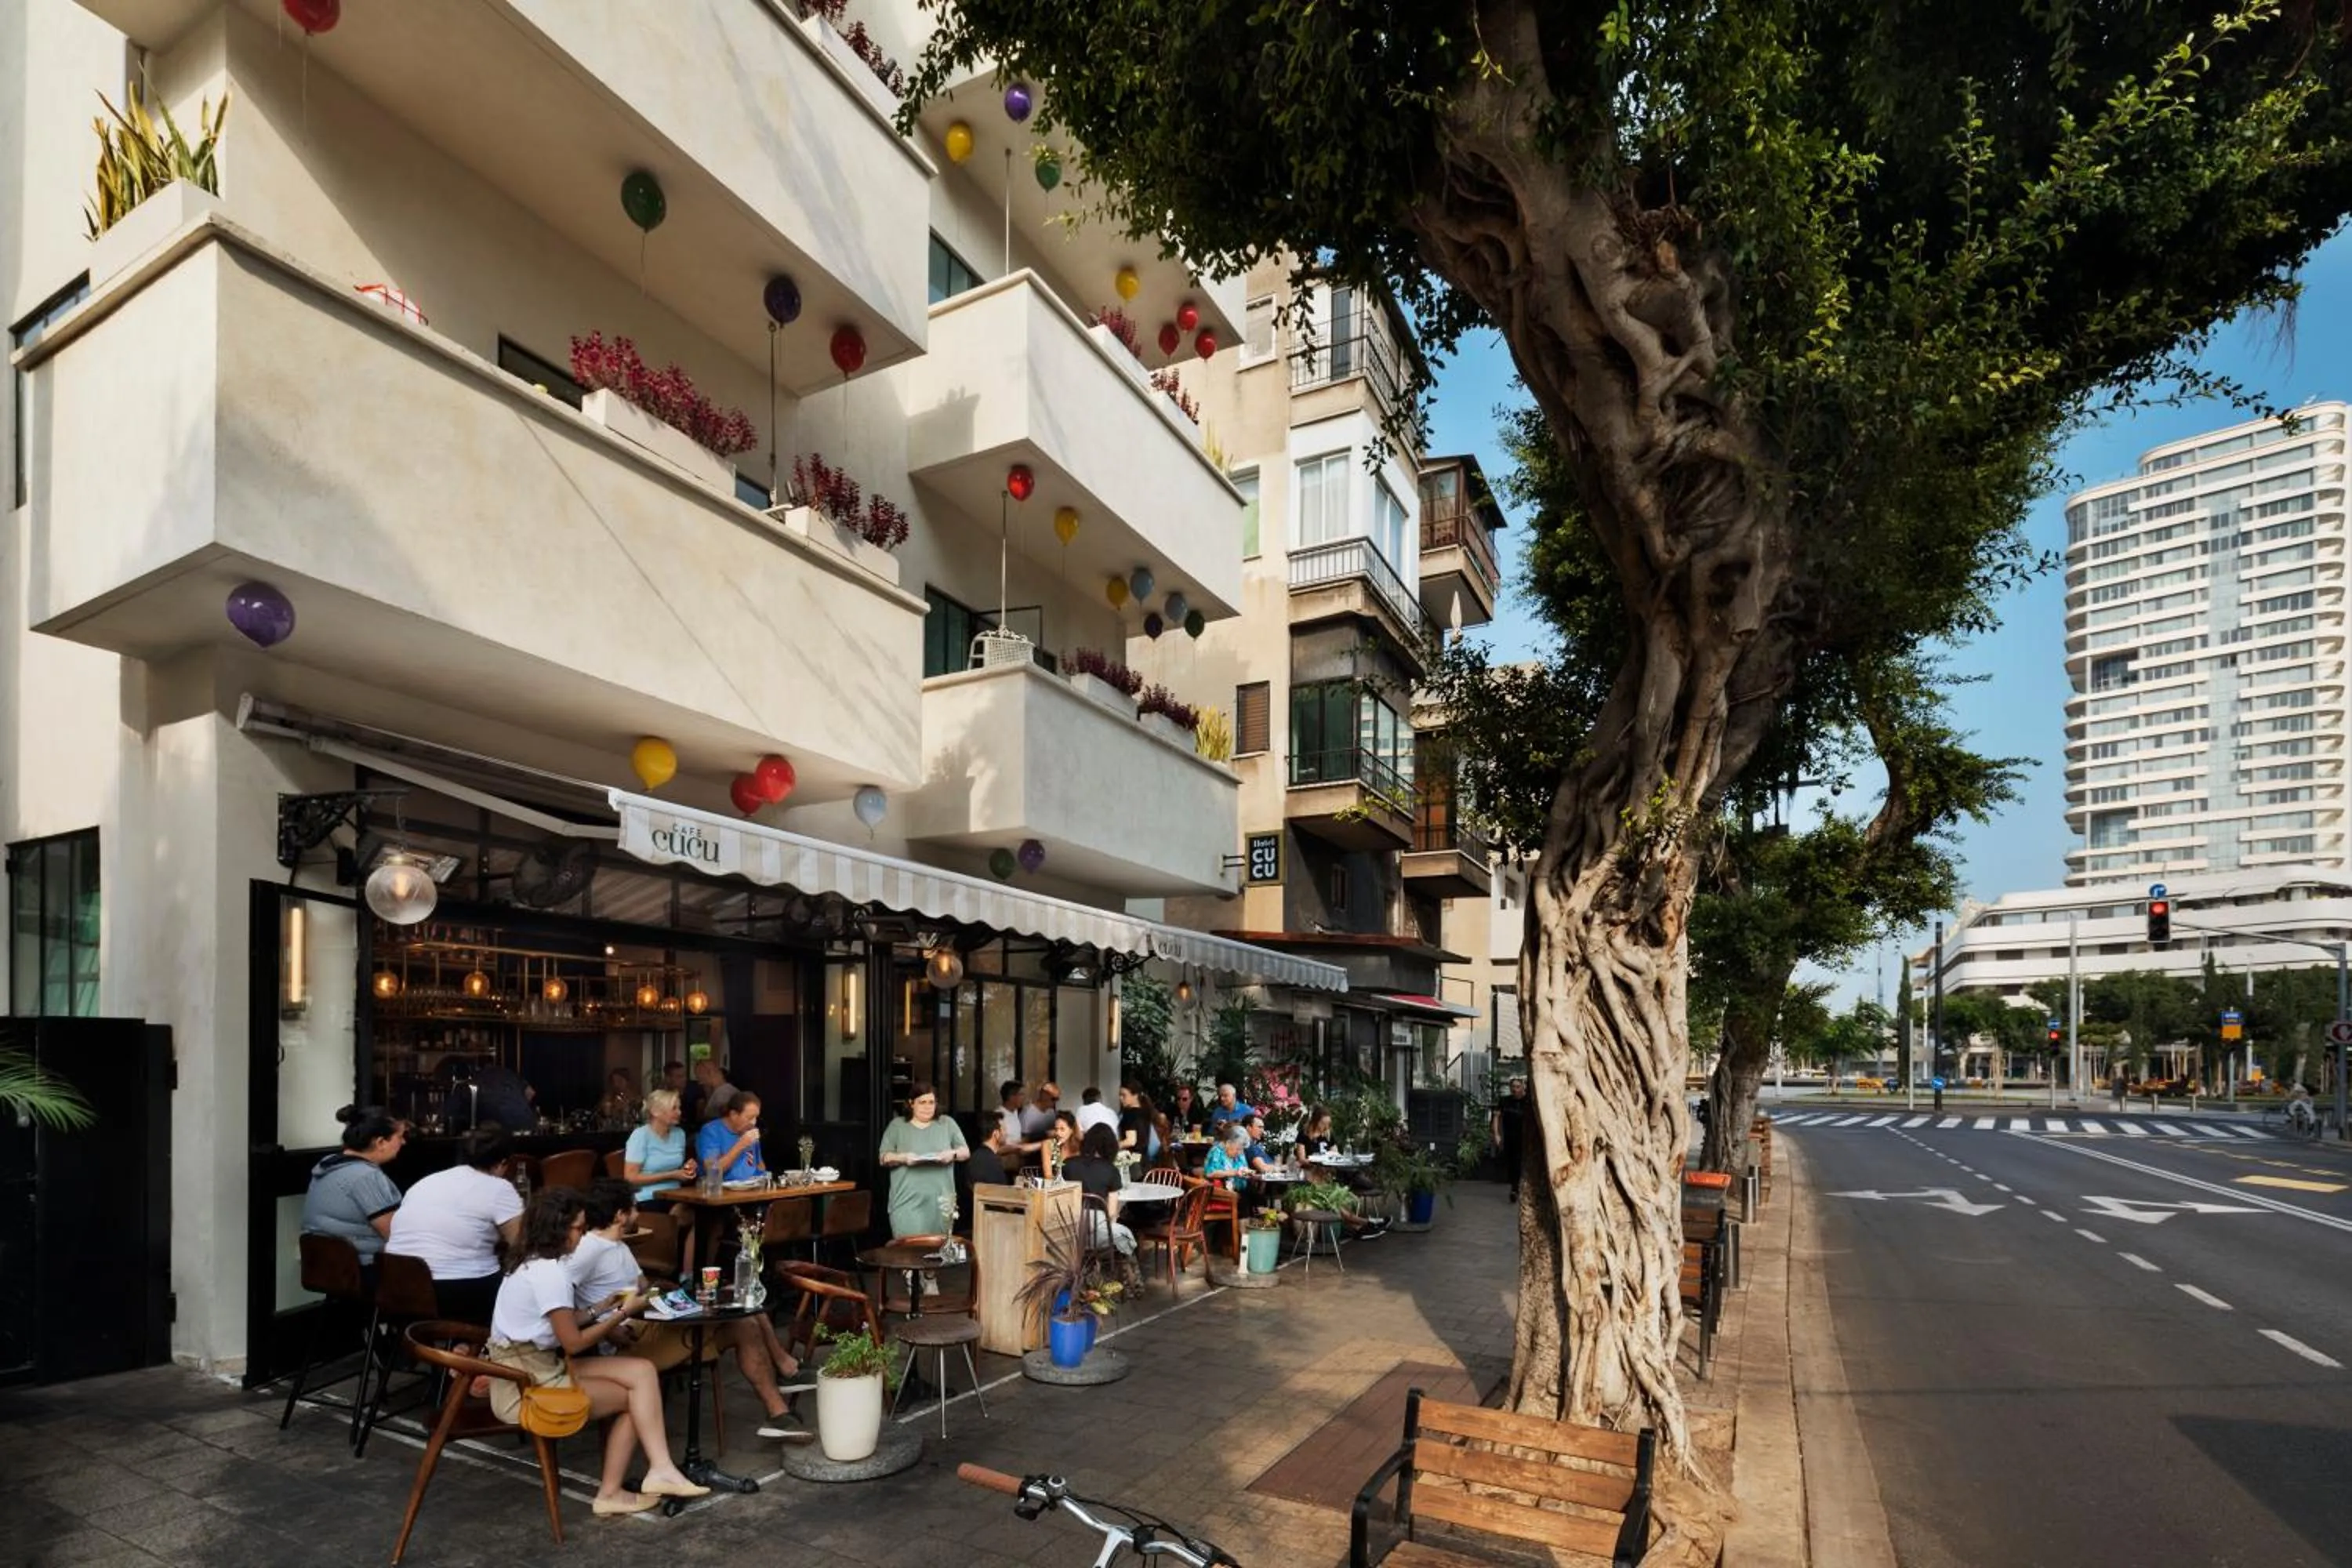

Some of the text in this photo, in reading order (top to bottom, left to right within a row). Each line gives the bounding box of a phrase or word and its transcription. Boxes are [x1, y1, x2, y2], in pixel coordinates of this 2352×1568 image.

[652, 829, 720, 863] cucu
[1252, 848, 1276, 863] CU
[1252, 863, 1276, 879] CU
